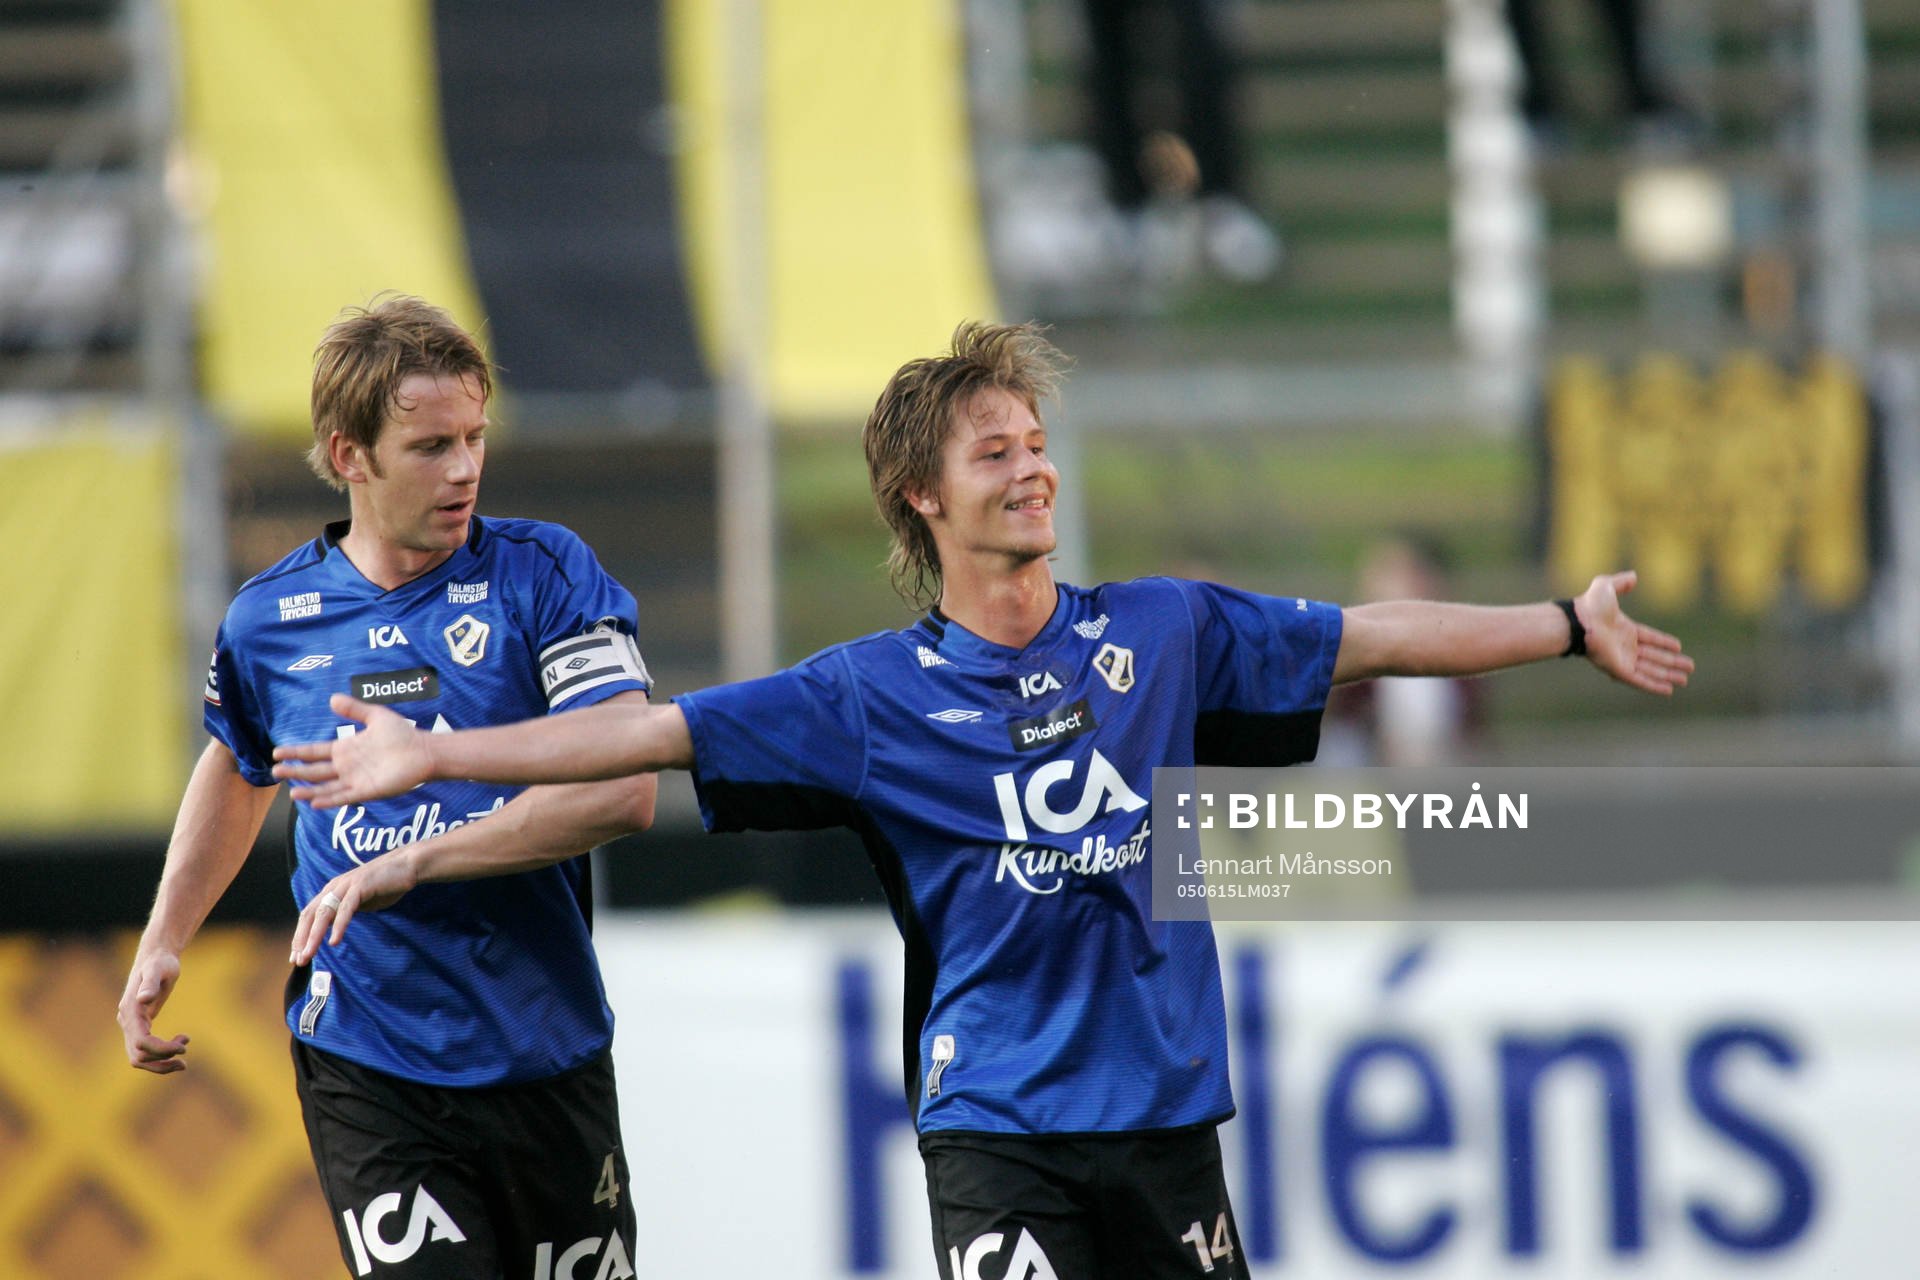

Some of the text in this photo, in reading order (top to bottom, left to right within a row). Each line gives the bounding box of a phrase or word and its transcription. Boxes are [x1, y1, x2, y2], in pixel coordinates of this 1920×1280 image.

[447, 580, 489, 594] HALMSTAD
[448, 589, 488, 604] TRYCKERI
[279, 591, 321, 611] HALMSTAD
[280, 603, 322, 622] TRYCKERI
[368, 624, 409, 649] ICA
[362, 676, 424, 698] Dialect
[1019, 671, 1063, 698] ICA
[1021, 711, 1082, 744] Dialect
[993, 747, 1149, 841] ICA
[994, 819, 1151, 895] Kundkort
[593, 1153, 620, 1209] 4
[343, 1183, 467, 1277] ICA
[1181, 1211, 1235, 1273] 14
